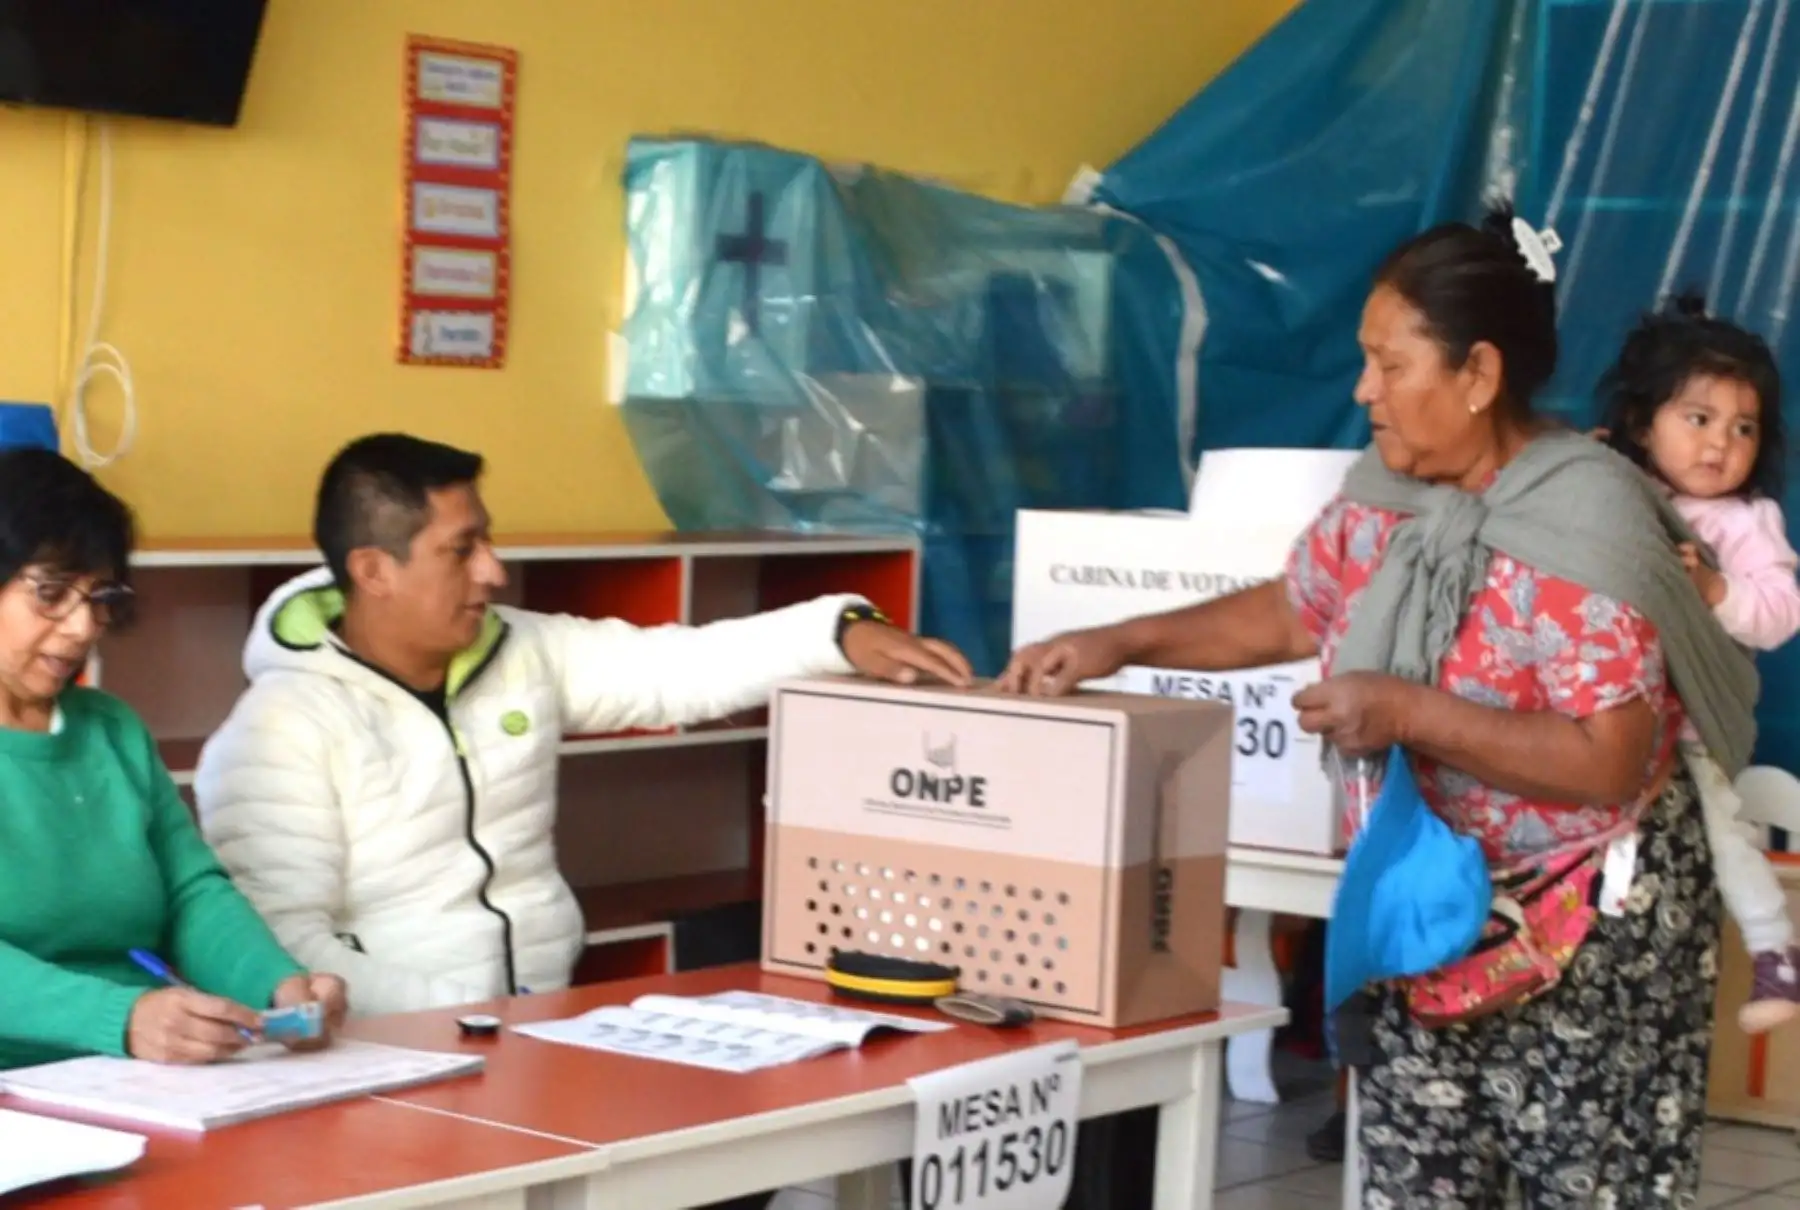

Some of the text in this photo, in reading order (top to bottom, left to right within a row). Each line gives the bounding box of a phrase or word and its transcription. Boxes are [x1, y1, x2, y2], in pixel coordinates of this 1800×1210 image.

[1049, 564, 1137, 588] CABINA
[1141, 569, 1173, 590] DE
[1236, 717, 1287, 758] 30
[890, 767, 987, 807] ONPE
[939, 1084, 1022, 1139] MESA
[920, 1119, 1068, 1210] 011530
